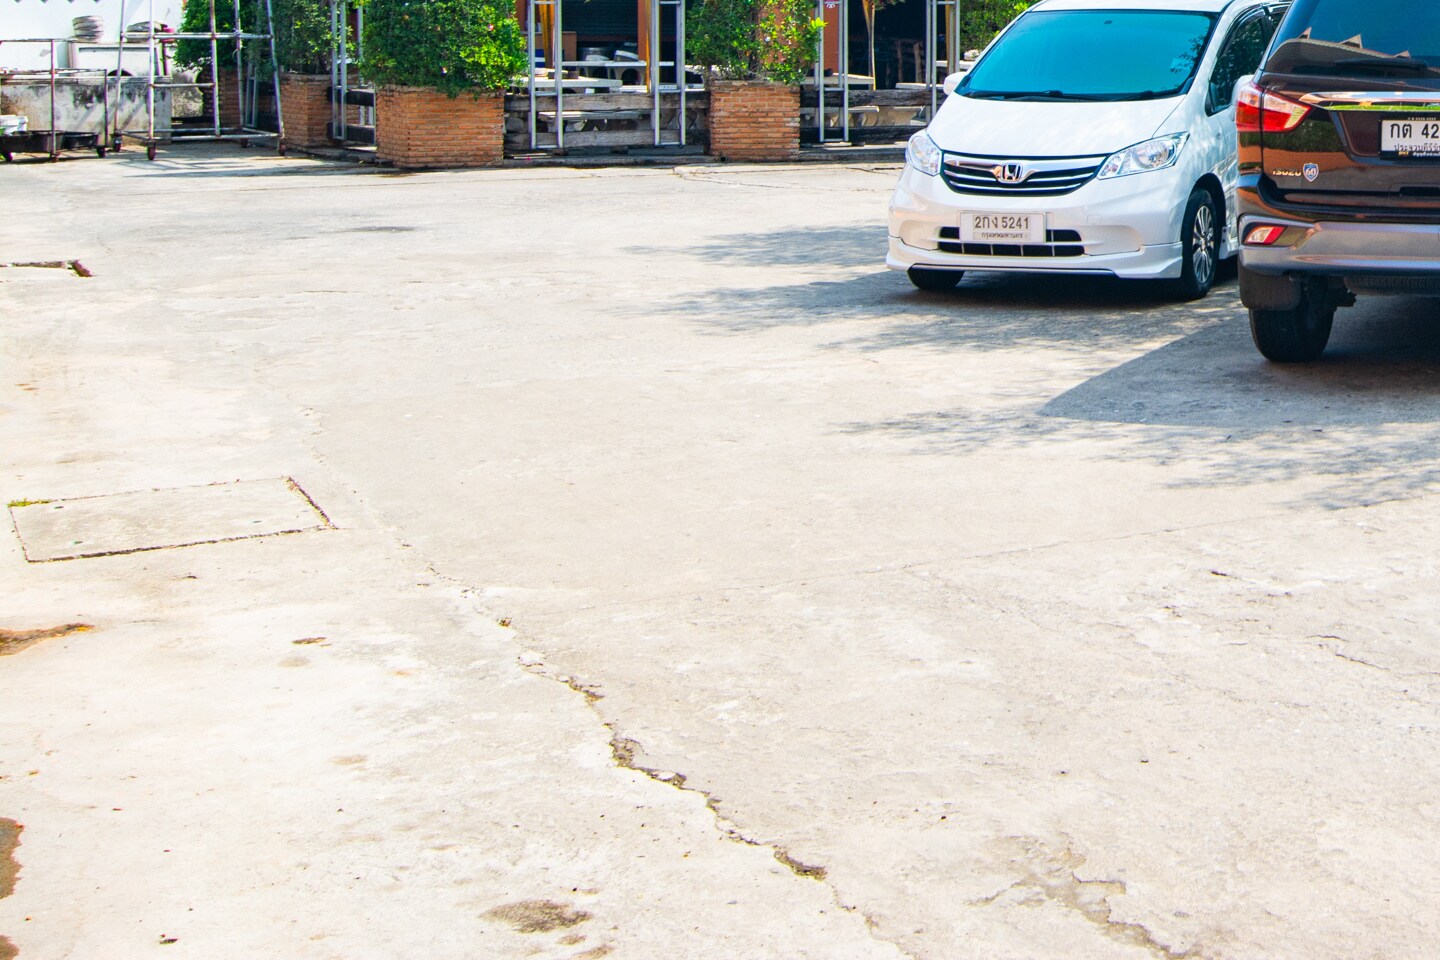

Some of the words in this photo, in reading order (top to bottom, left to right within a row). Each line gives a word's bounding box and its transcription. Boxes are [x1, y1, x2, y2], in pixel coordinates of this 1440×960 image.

[1390, 123, 1412, 139] กต
[1305, 167, 1317, 176] 60
[1001, 216, 1029, 230] 5241
